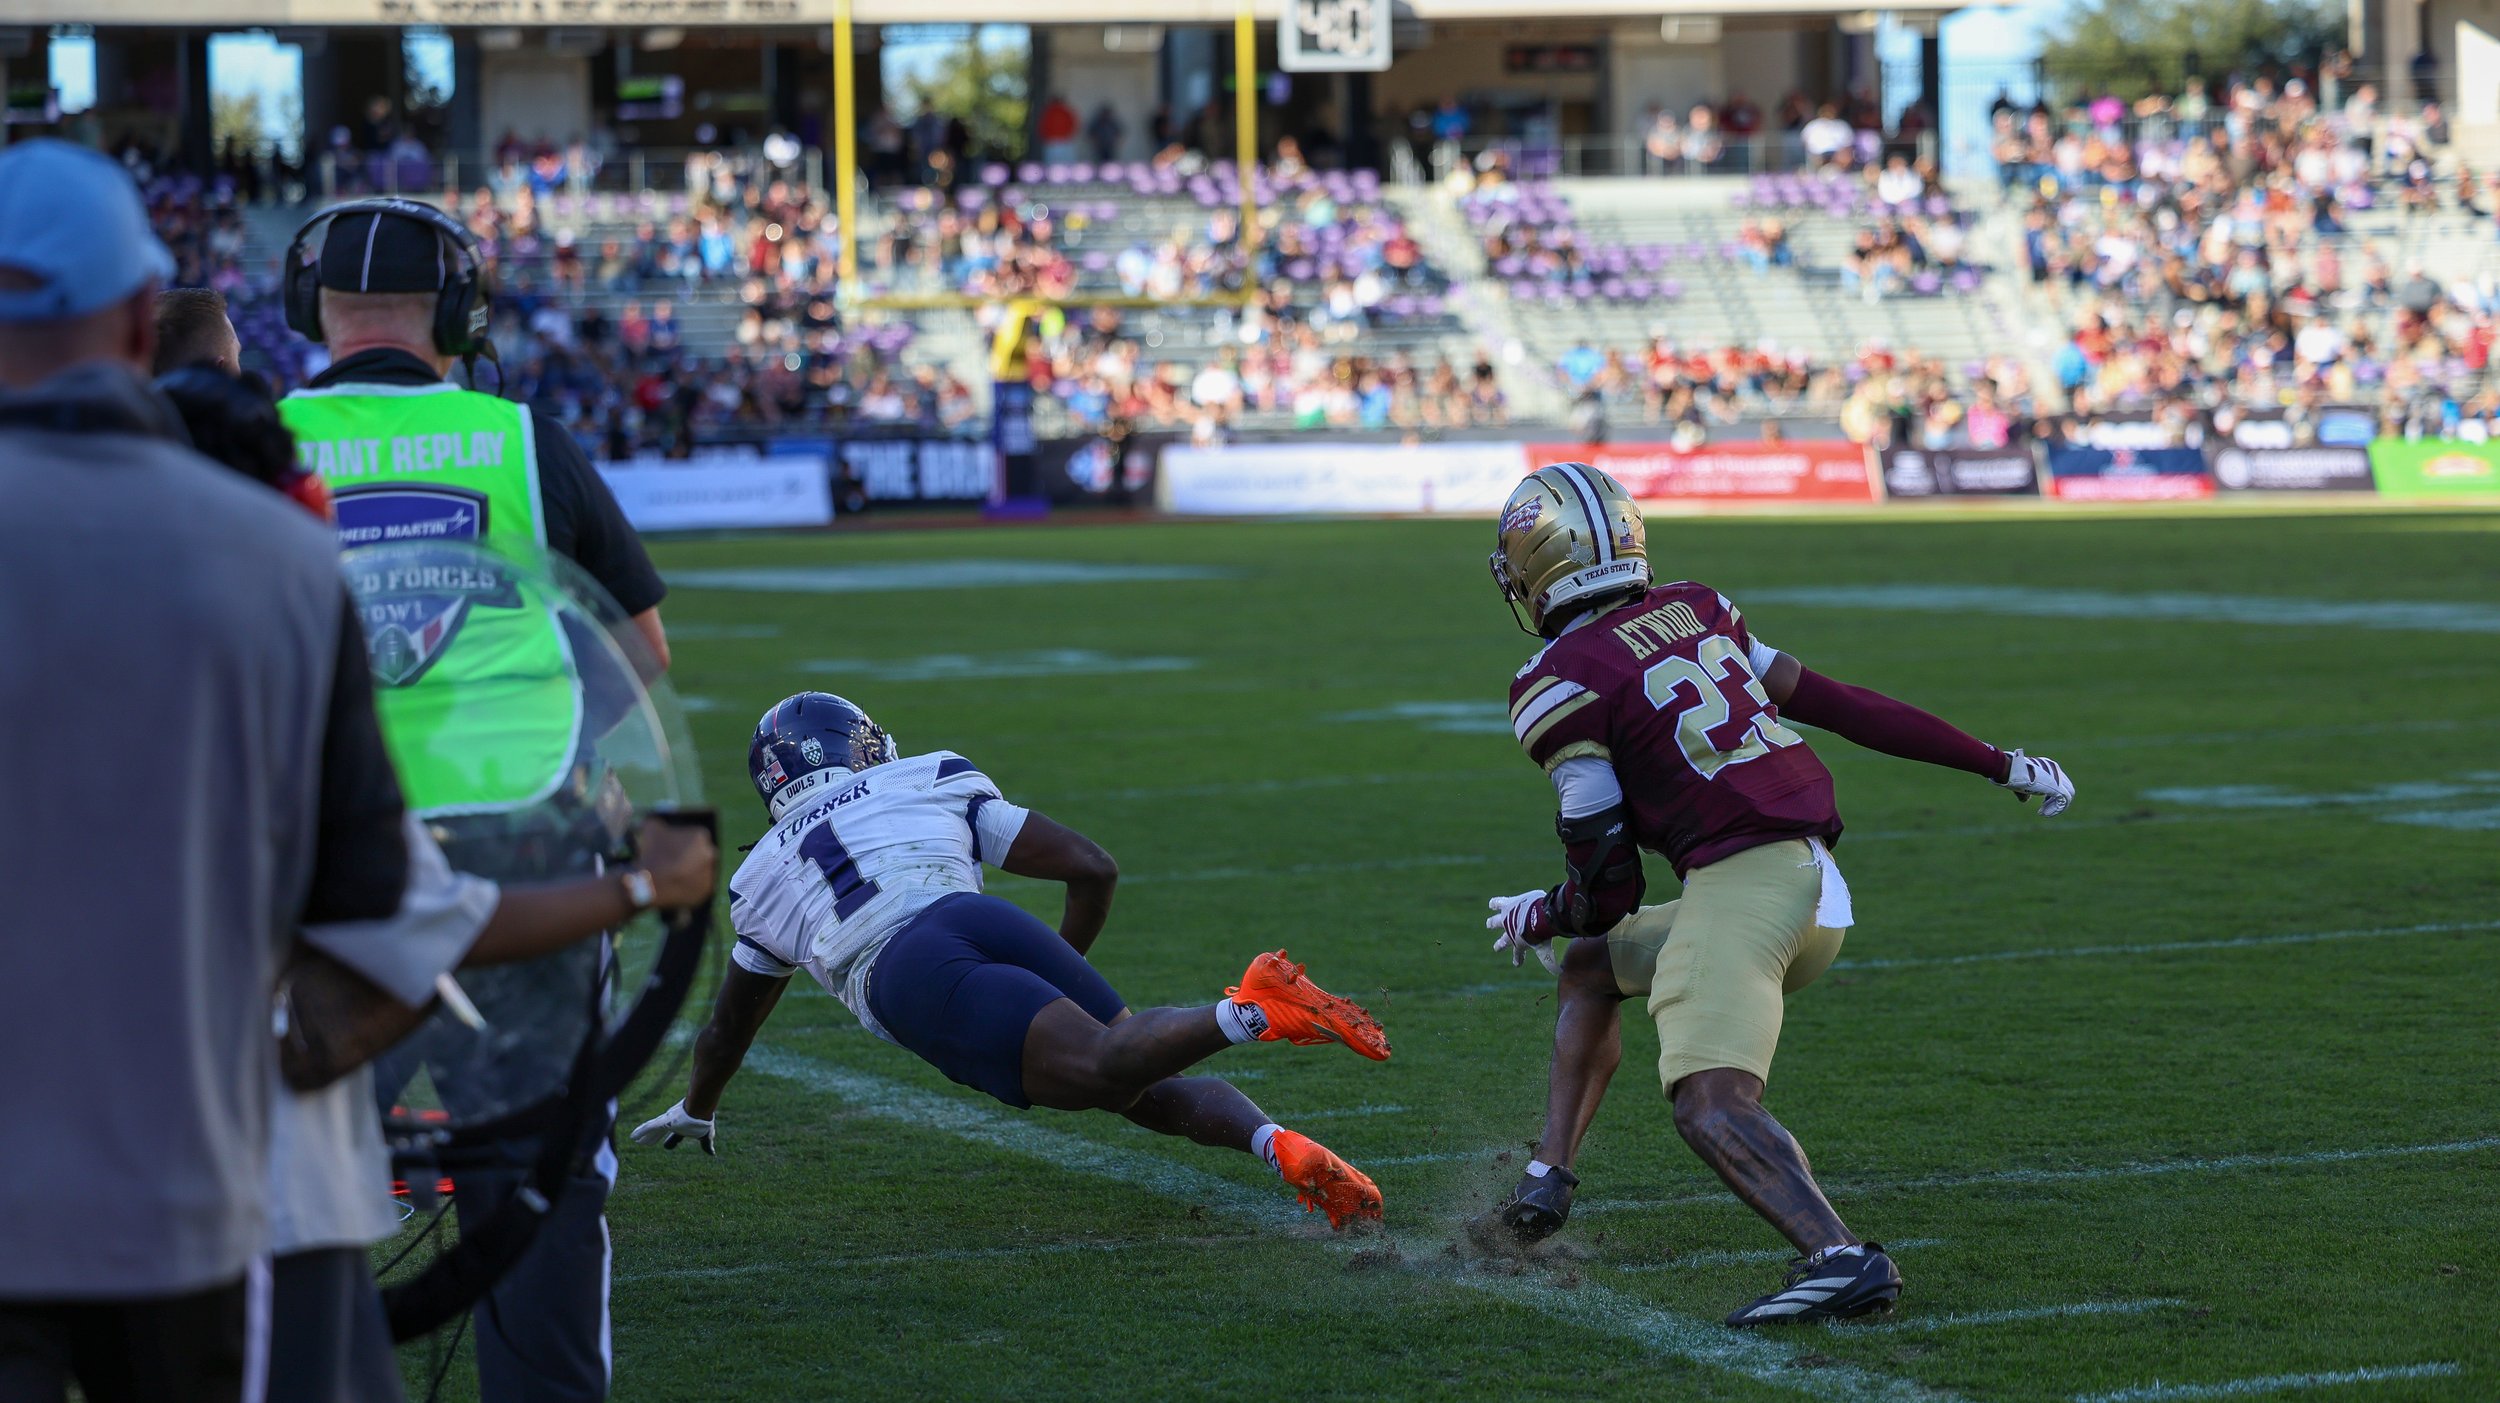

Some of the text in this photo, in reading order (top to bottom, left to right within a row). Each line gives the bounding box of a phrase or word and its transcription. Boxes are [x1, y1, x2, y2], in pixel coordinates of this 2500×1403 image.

[1298, 0, 1372, 55] 40
[393, 432, 505, 473] REPLAY
[385, 520, 448, 537] MARTIN
[388, 565, 496, 591] FORCES
[1584, 563, 1631, 581] TEXAS STATE
[1612, 601, 1707, 660] ATWOOD
[1643, 634, 1805, 781] 23
[786, 775, 815, 799] OWLS
[777, 780, 871, 848] TURNER
[797, 818, 882, 923] 1
